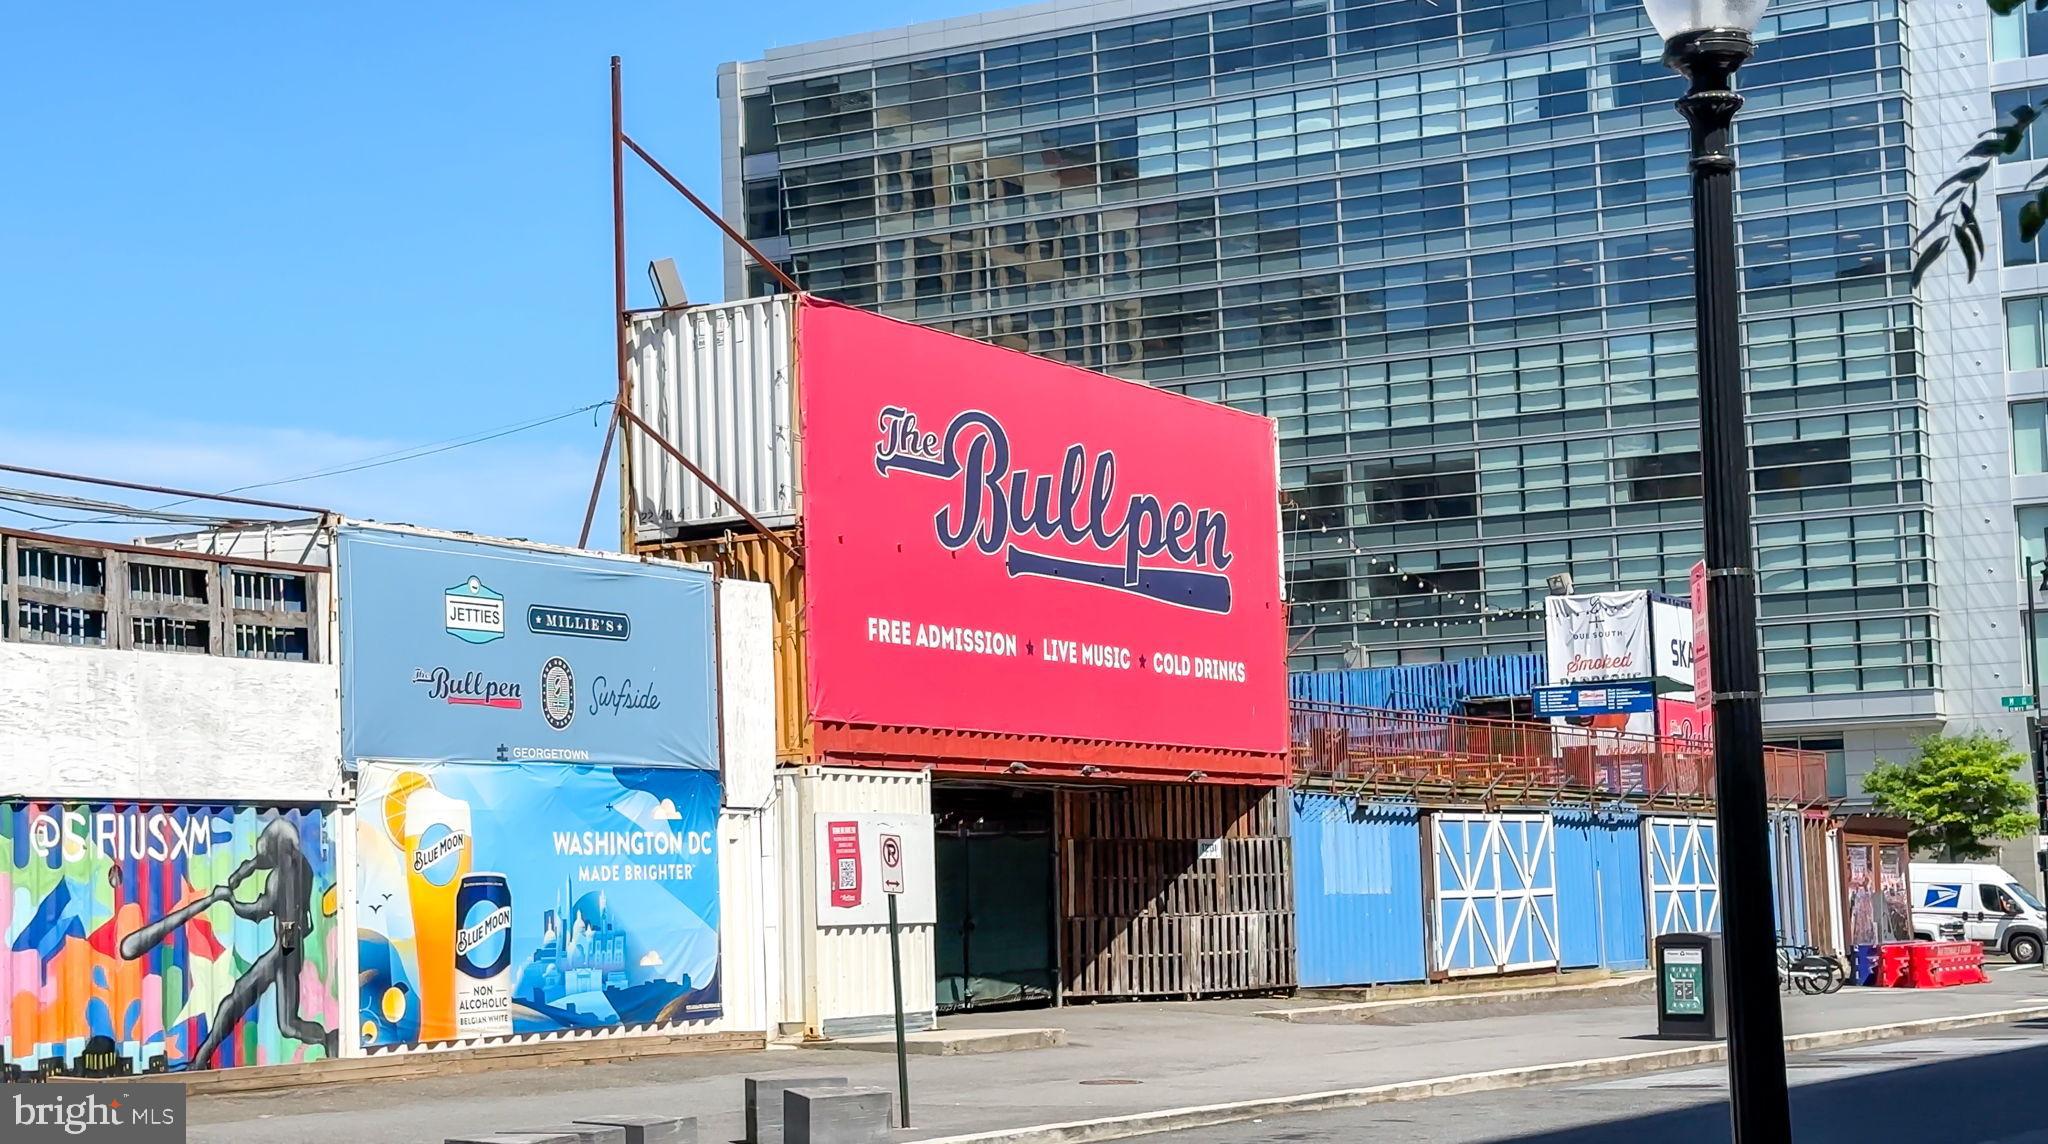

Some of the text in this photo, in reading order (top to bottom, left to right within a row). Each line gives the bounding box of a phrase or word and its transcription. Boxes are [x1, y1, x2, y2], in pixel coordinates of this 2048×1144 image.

[876, 405, 1234, 587] The Bullpen
[450, 606, 500, 625] JETTIES
[546, 614, 614, 632] MILLIE'S
[1592, 630, 1623, 639] SOUTH
[868, 617, 1246, 683] FREE ADMISSION LIVE MUSIC COLD DRINKS
[1566, 651, 1633, 677] Smoked
[428, 667, 521, 703] Bullpen
[590, 676, 661, 716] Surfside
[513, 747, 589, 761] GEORGETOWN
[30, 812, 212, 863] @SIRIUSXM
[553, 831, 712, 856] WASHINGTON DC
[413, 833, 464, 871] BLUE MOON
[578, 863, 693, 882] MADE BRIGHTER
[457, 910, 510, 953] BLUE MOON
[473, 985, 493, 996] NON
[459, 997, 508, 1010] ALCOHOLIC
[460, 1014, 508, 1026] BELGIAN WHITE
